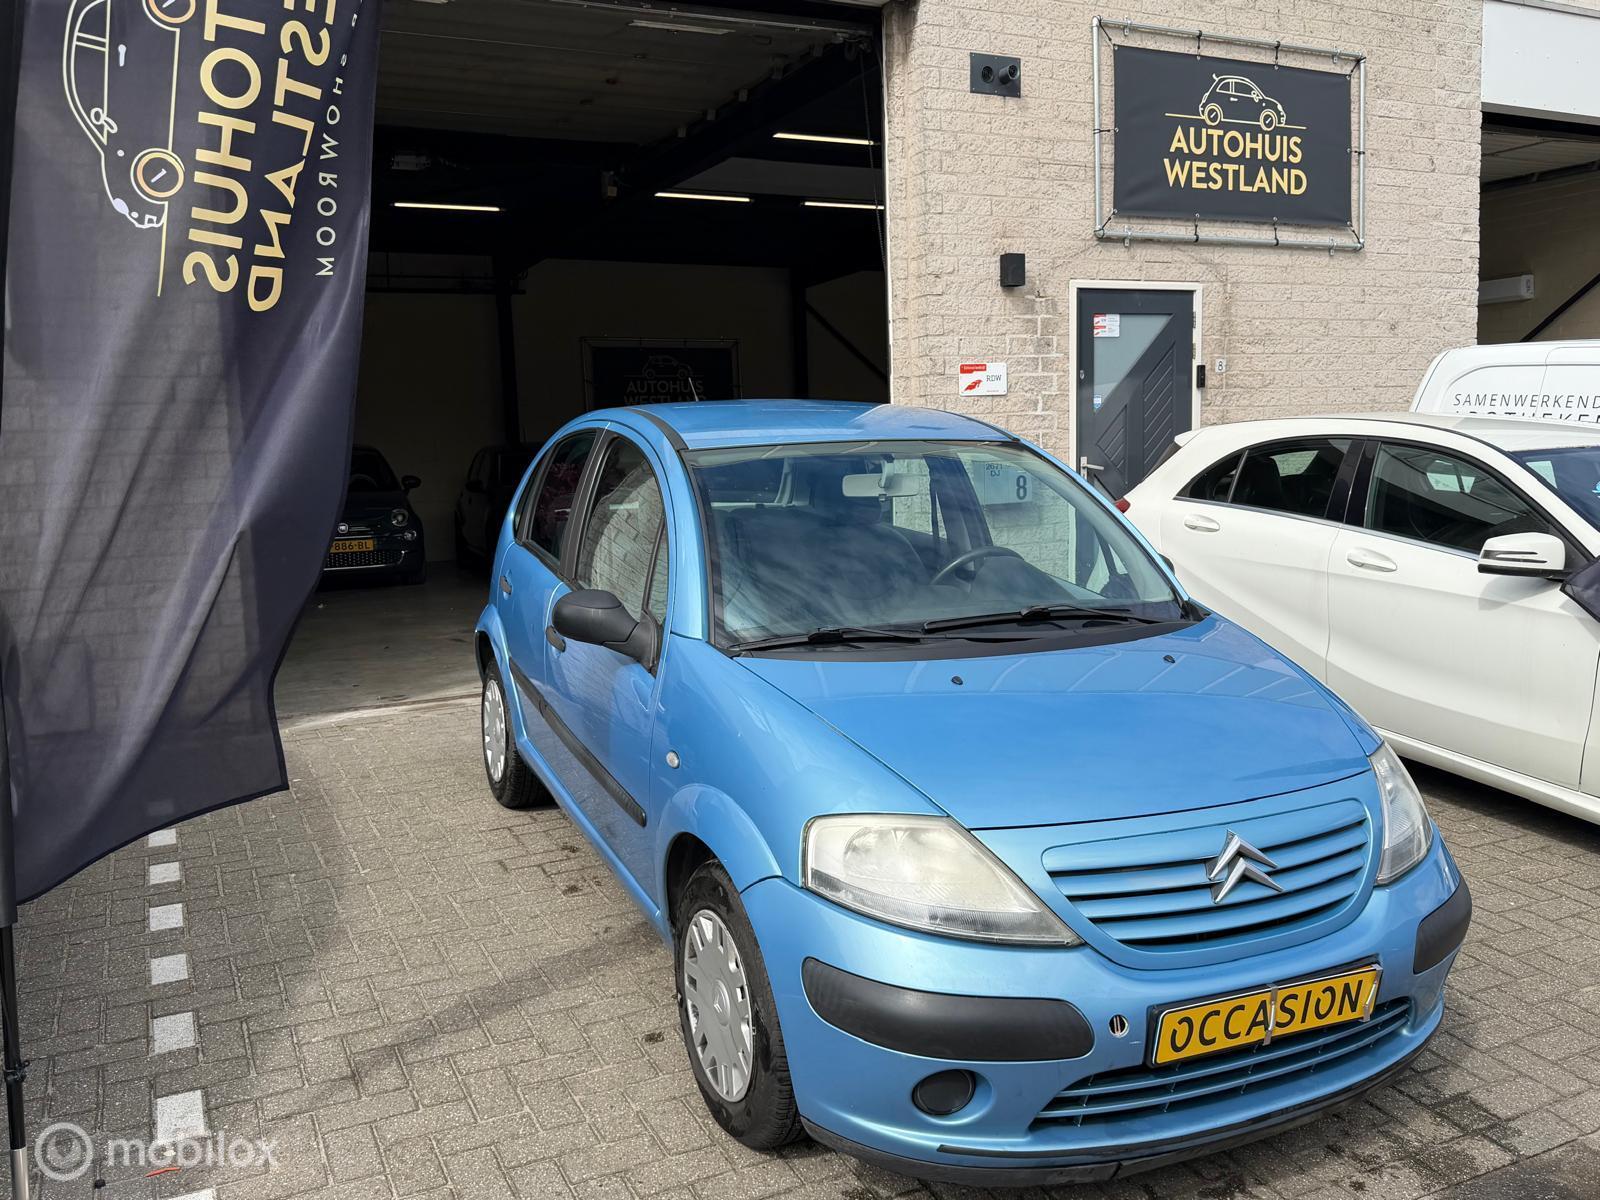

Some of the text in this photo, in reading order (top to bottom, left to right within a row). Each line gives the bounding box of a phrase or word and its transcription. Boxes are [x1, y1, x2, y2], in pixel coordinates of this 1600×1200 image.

[1169, 124, 1303, 165] AUTOHUIS
[1163, 157, 1308, 196] WESTLAND
[986, 374, 1002, 382] RDW
[1217, 360, 1224, 371] 8
[626, 380, 704, 393] AUTOHUS
[1015, 474, 1027, 500] 8
[1170, 979, 1364, 1053] OCCASION
